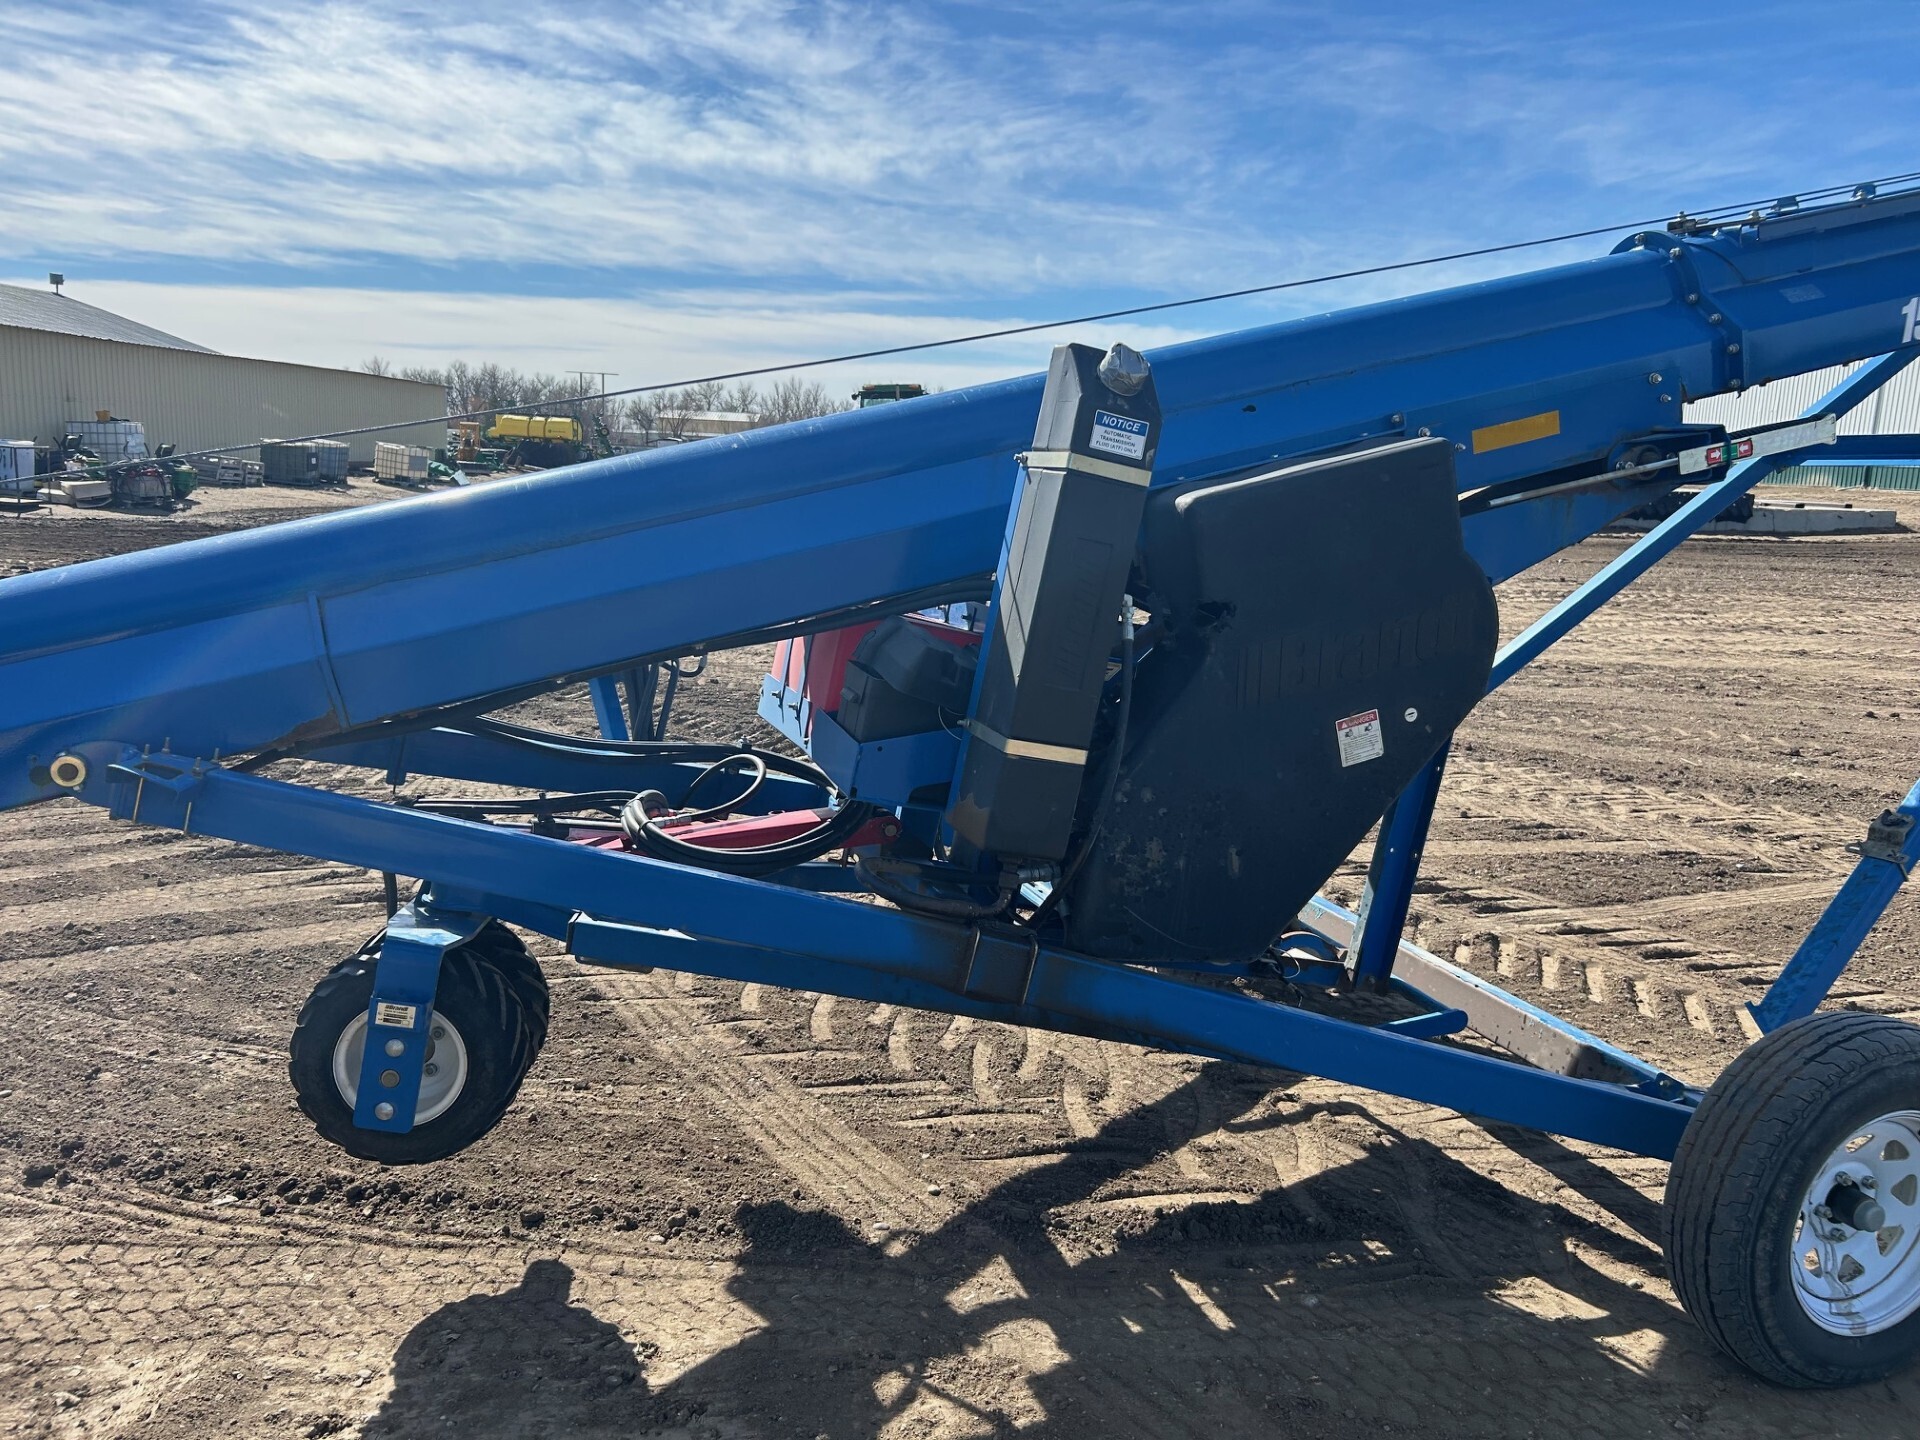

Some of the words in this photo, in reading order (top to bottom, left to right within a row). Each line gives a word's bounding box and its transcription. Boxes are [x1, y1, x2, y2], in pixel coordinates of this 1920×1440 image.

[1102, 415, 1141, 431] NOTICE
[1100, 434, 1136, 448] TRANSMISSION
[1104, 429, 1132, 440] AUTOMATIC
[1095, 440, 1110, 448] FLUID
[1110, 443, 1123, 451] (ATF)
[1124, 447, 1138, 455] ONLY
